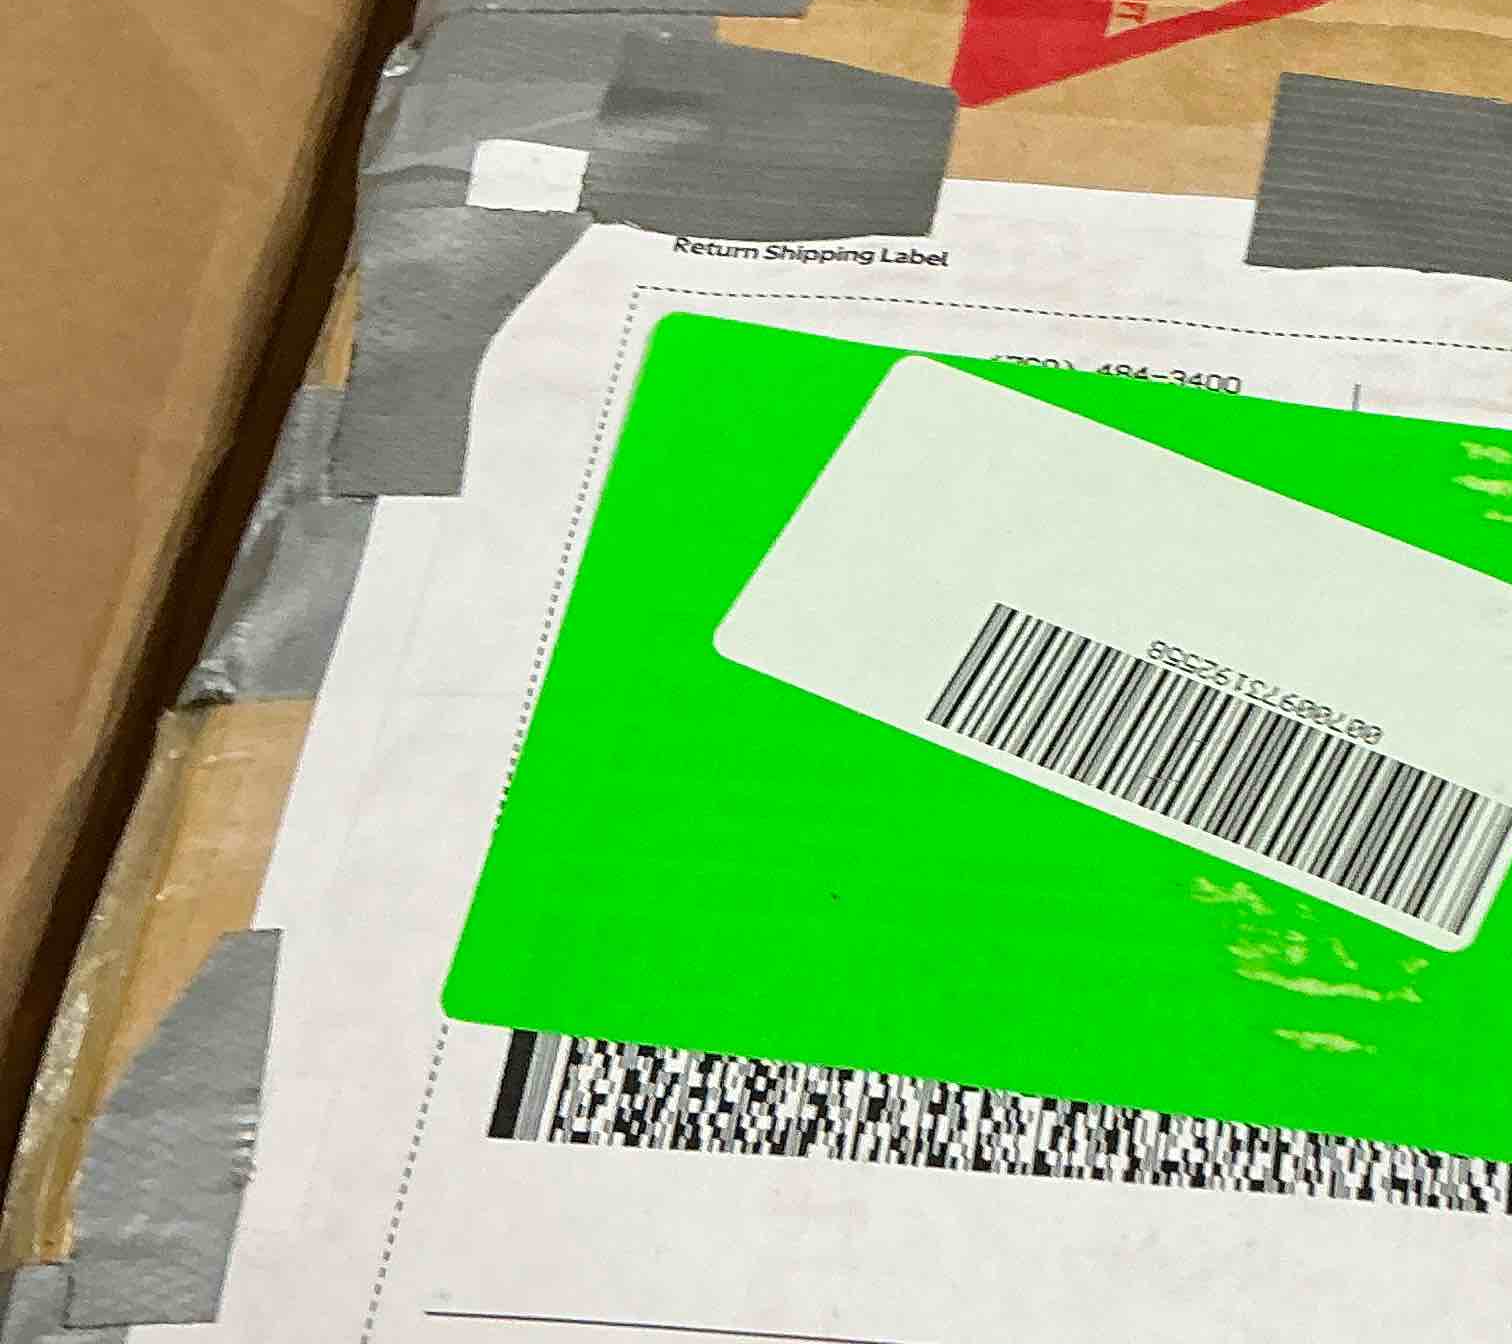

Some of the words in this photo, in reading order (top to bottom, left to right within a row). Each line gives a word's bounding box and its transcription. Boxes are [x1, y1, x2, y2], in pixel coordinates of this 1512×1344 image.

[673, 236, 759, 259] Return
[763, 245, 875, 265] Shipping
[879, 248, 949, 267] Label
